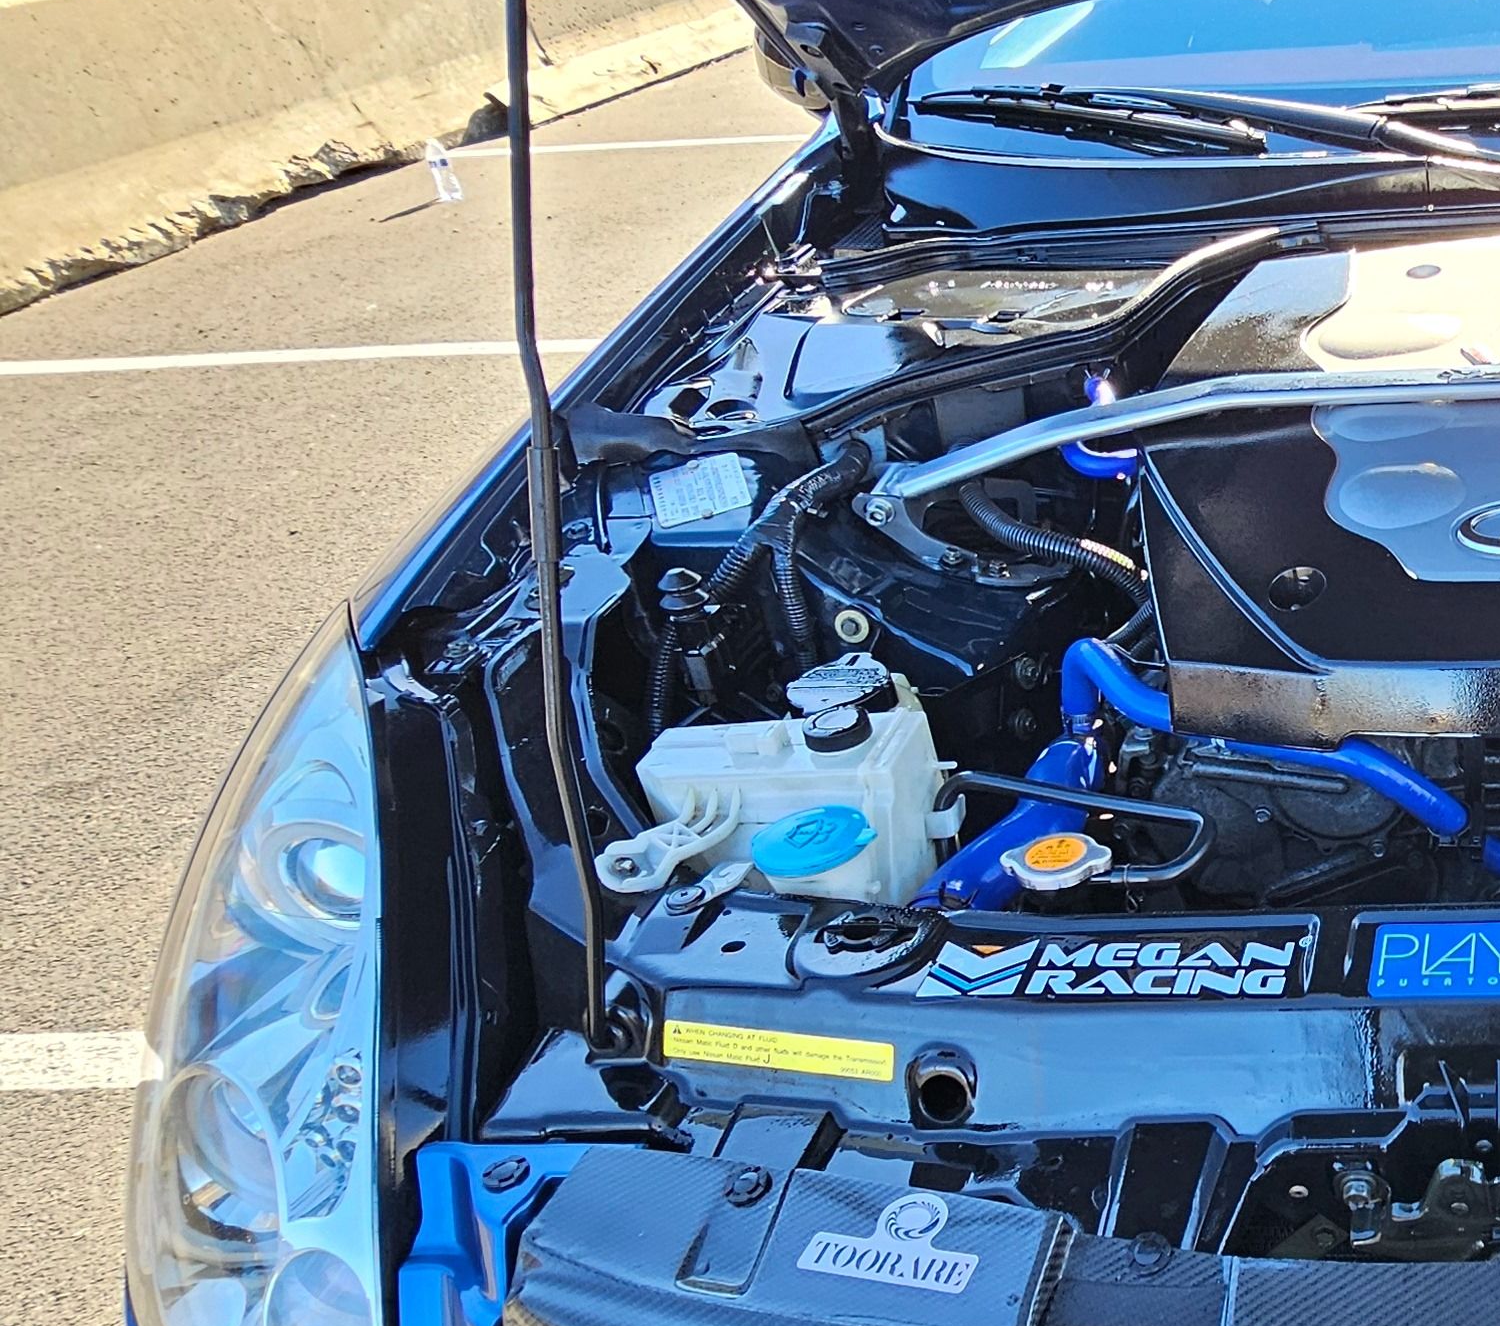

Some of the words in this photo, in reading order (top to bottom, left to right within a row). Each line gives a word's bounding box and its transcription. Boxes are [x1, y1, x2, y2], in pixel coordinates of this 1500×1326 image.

[1037, 942, 1295, 967] MEGAN
[1024, 968, 1286, 996] RACING
[1377, 976, 1499, 987] PUERTO
[673, 1037, 693, 1045] Nissan
[686, 1028, 705, 1037] WHEN
[708, 1030, 744, 1041] CHANGING
[703, 1050, 723, 1059] Nissan
[763, 1054, 771, 1064] J
[814, 1240, 970, 1286] TOORARE
